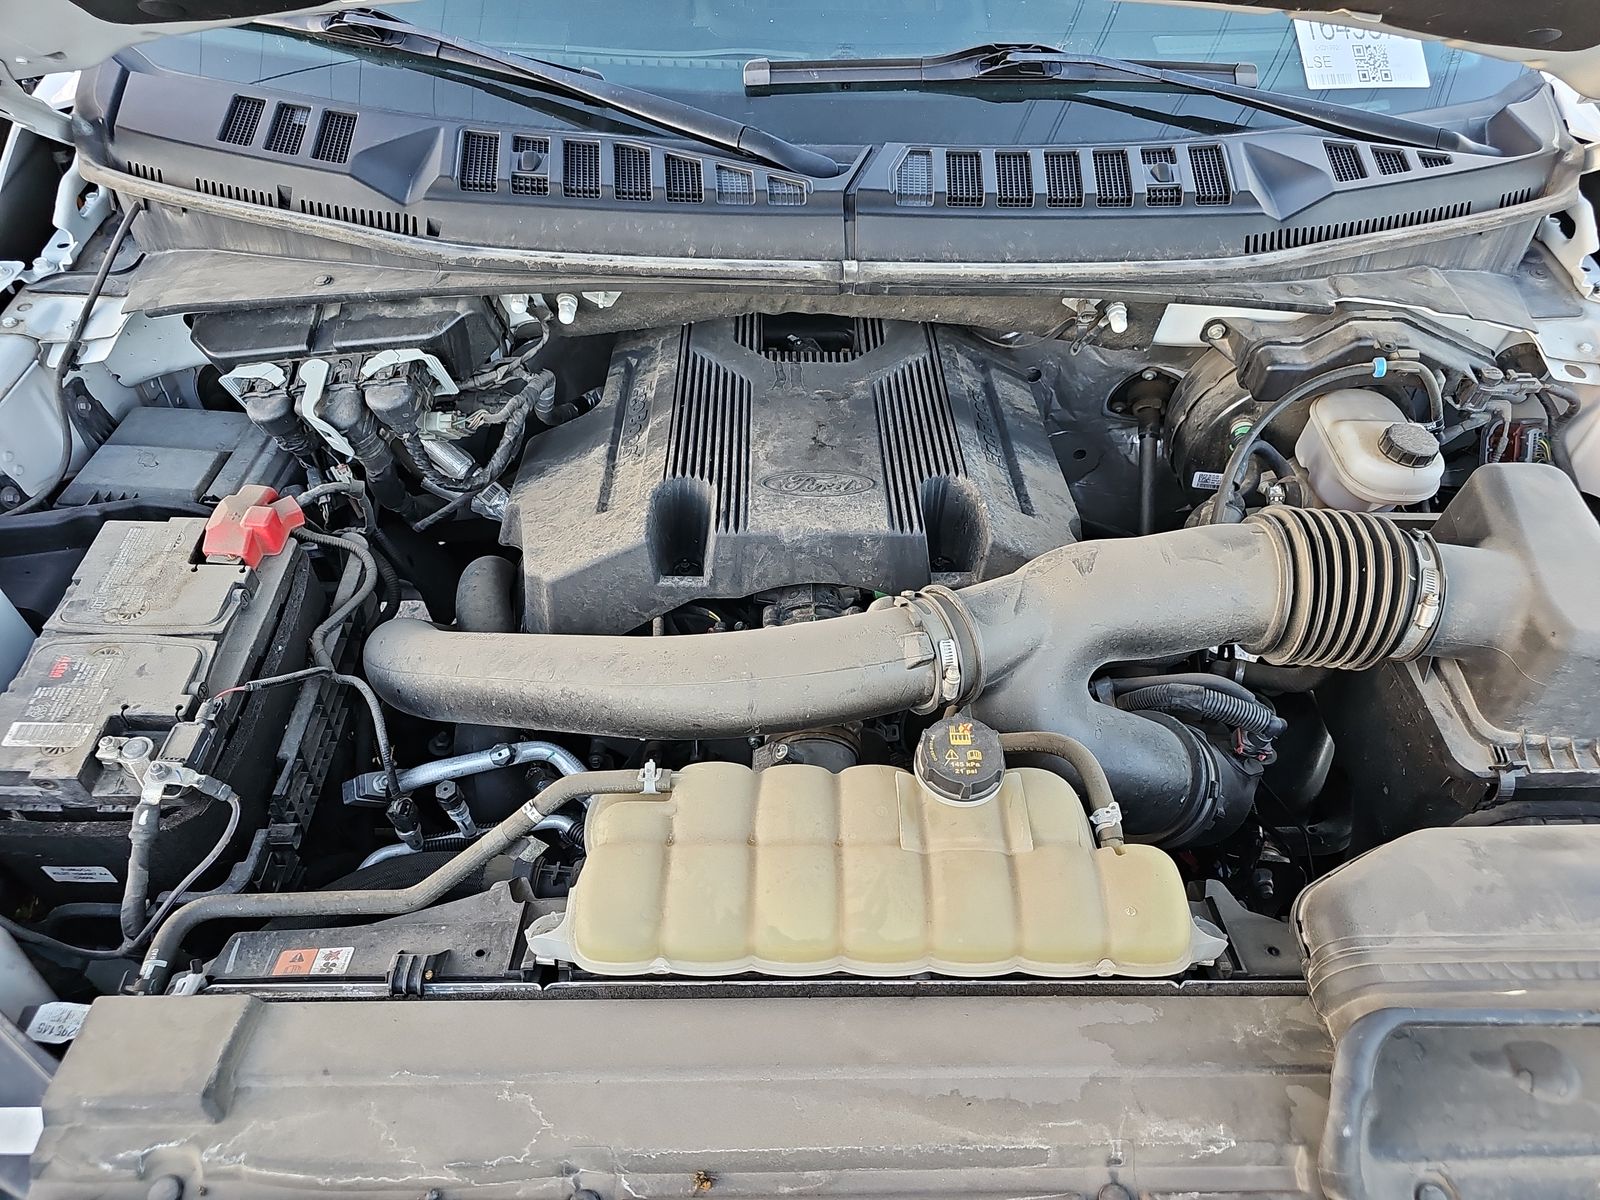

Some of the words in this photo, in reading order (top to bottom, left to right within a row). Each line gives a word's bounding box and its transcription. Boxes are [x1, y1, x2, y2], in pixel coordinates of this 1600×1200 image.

[1304, 55, 1334, 69] LSE
[781, 474, 855, 492] Ford
[966, 768, 978, 776] psi
